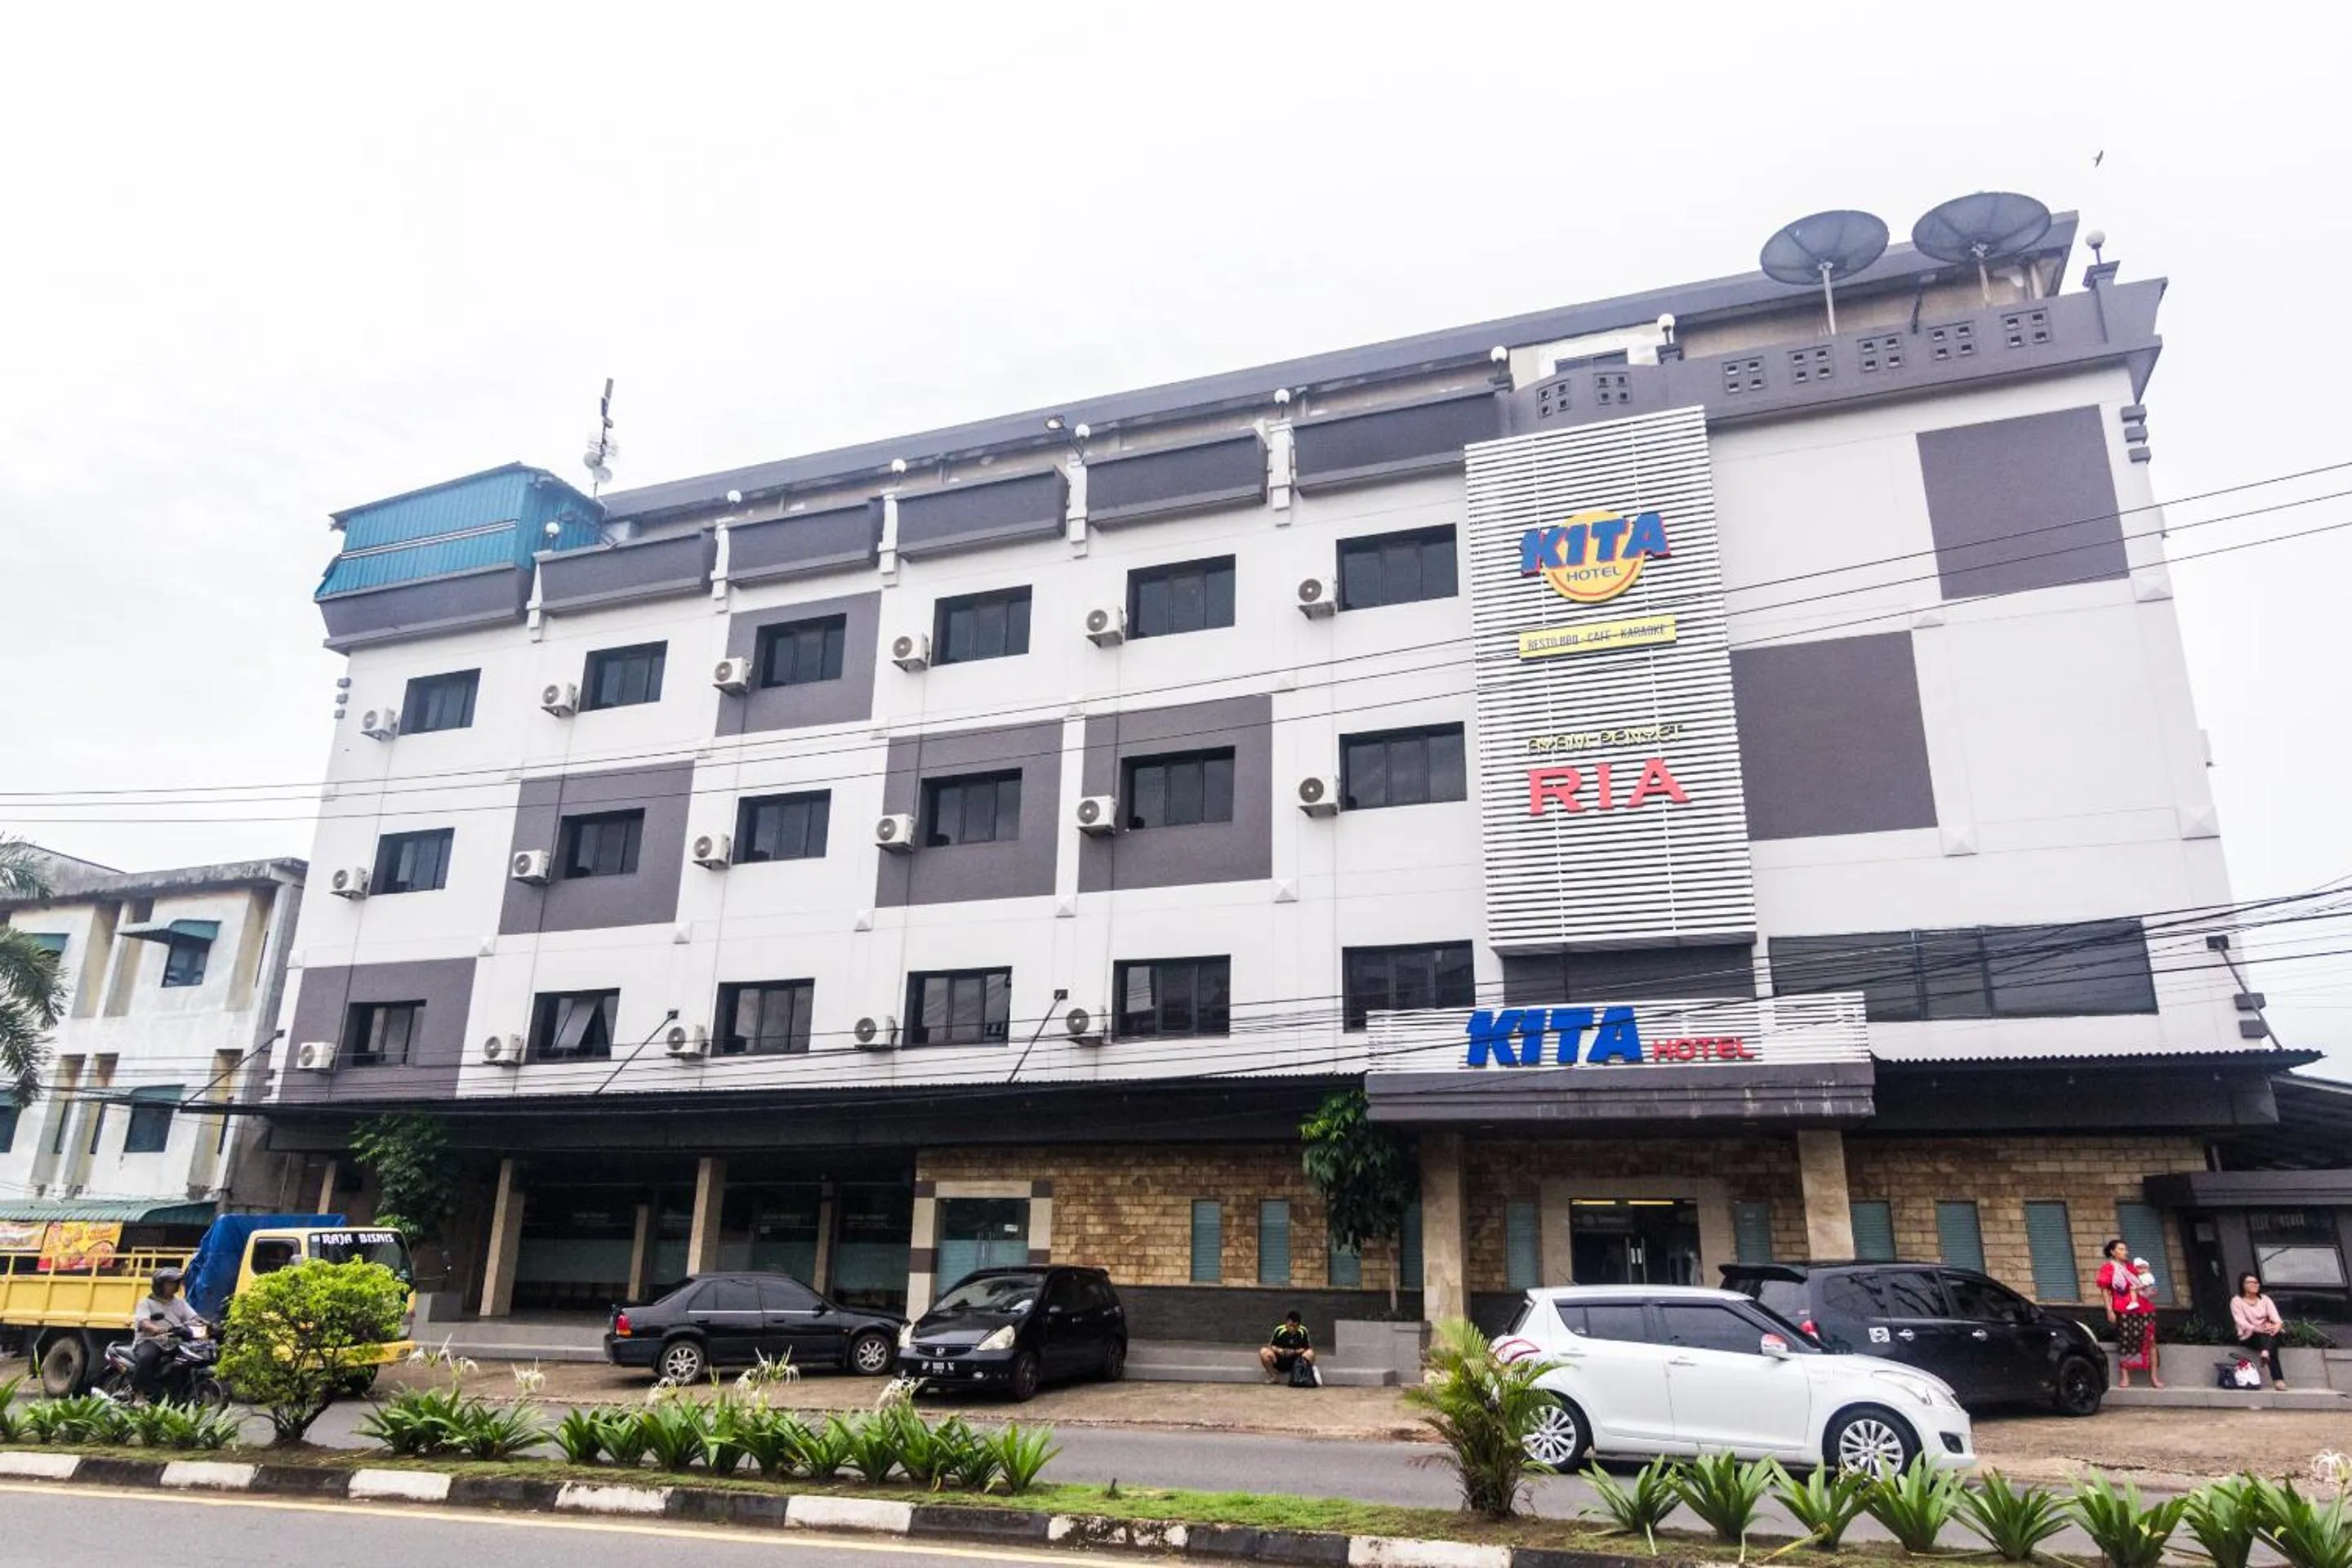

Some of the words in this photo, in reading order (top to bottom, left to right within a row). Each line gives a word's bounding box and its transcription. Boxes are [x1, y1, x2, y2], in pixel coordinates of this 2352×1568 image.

[1520, 512, 1672, 577] KITA
[1566, 565, 1622, 581] HOTEL
[1587, 629, 1611, 643] CAFE
[1620, 623, 1666, 639] KARAOKE
[1526, 756, 1692, 817] RIA
[1466, 1006, 1644, 1067] KITA
[1652, 1036, 1755, 1061] HOTEL
[321, 1233, 352, 1245] RAJA
[359, 1233, 394, 1243] BISNIS
